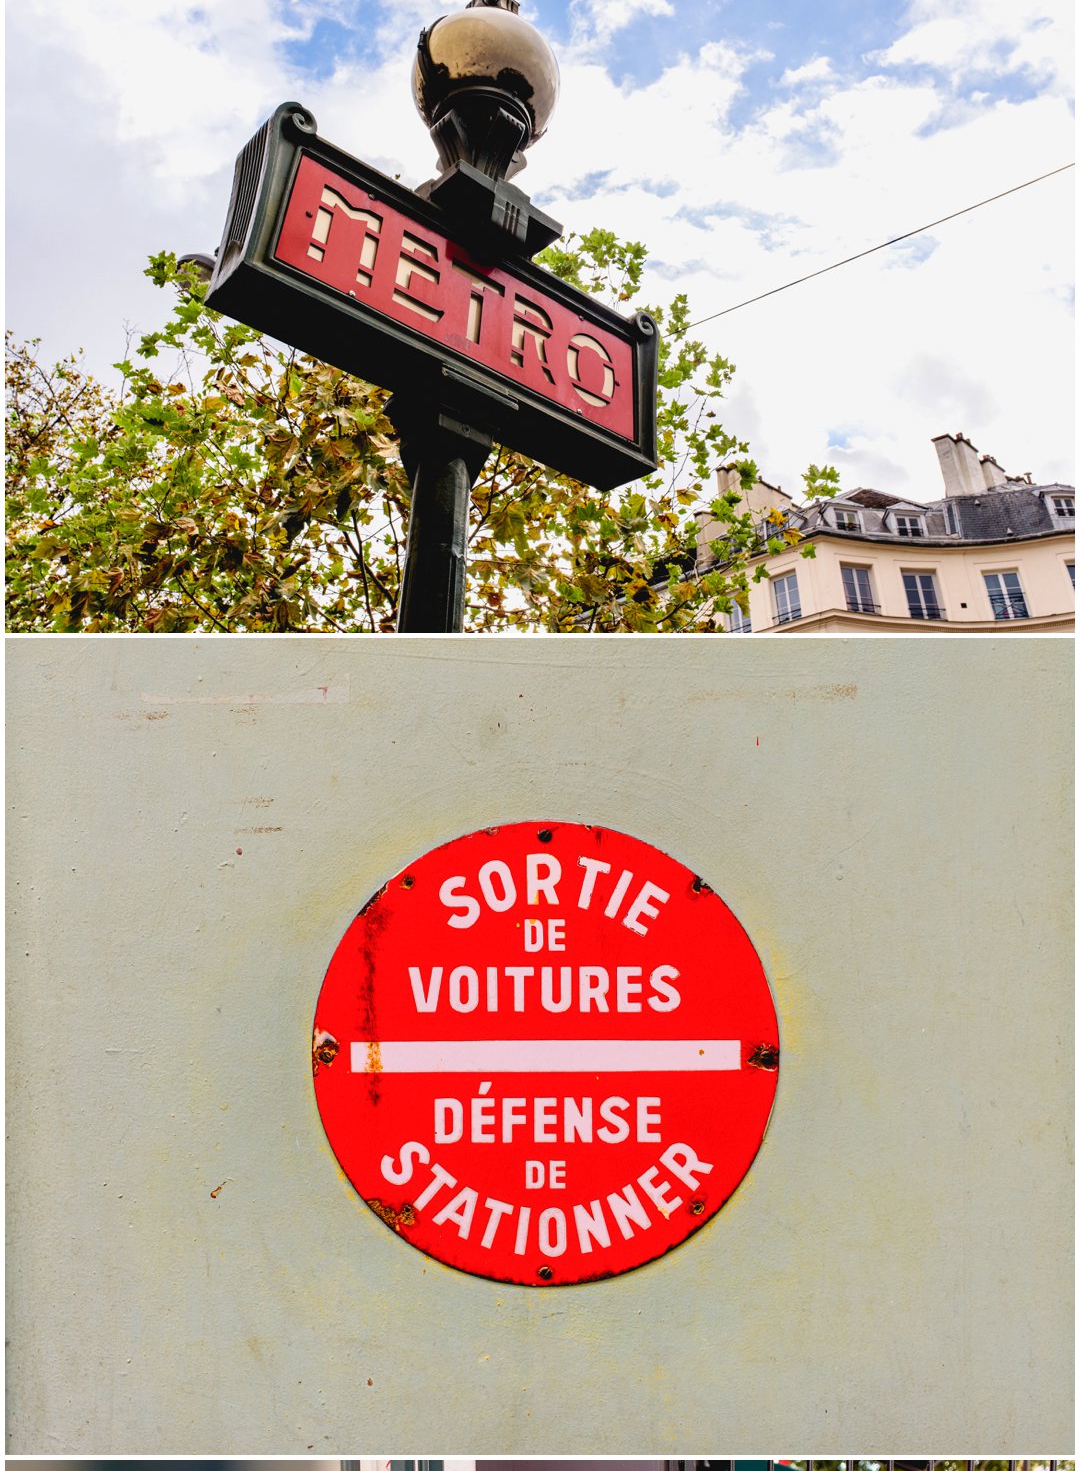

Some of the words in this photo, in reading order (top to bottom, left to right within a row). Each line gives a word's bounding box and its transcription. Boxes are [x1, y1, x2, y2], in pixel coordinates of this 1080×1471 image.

[305, 183, 617, 408] METRO
[439, 853, 670, 937] SORTIE
[524, 919, 566, 952] DE
[408, 964, 681, 1013] VOITURES
[434, 1082, 661, 1144] DÉFENSE
[380, 1141, 714, 1257] STATIONNER
[525, 1161, 566, 1190] DE
